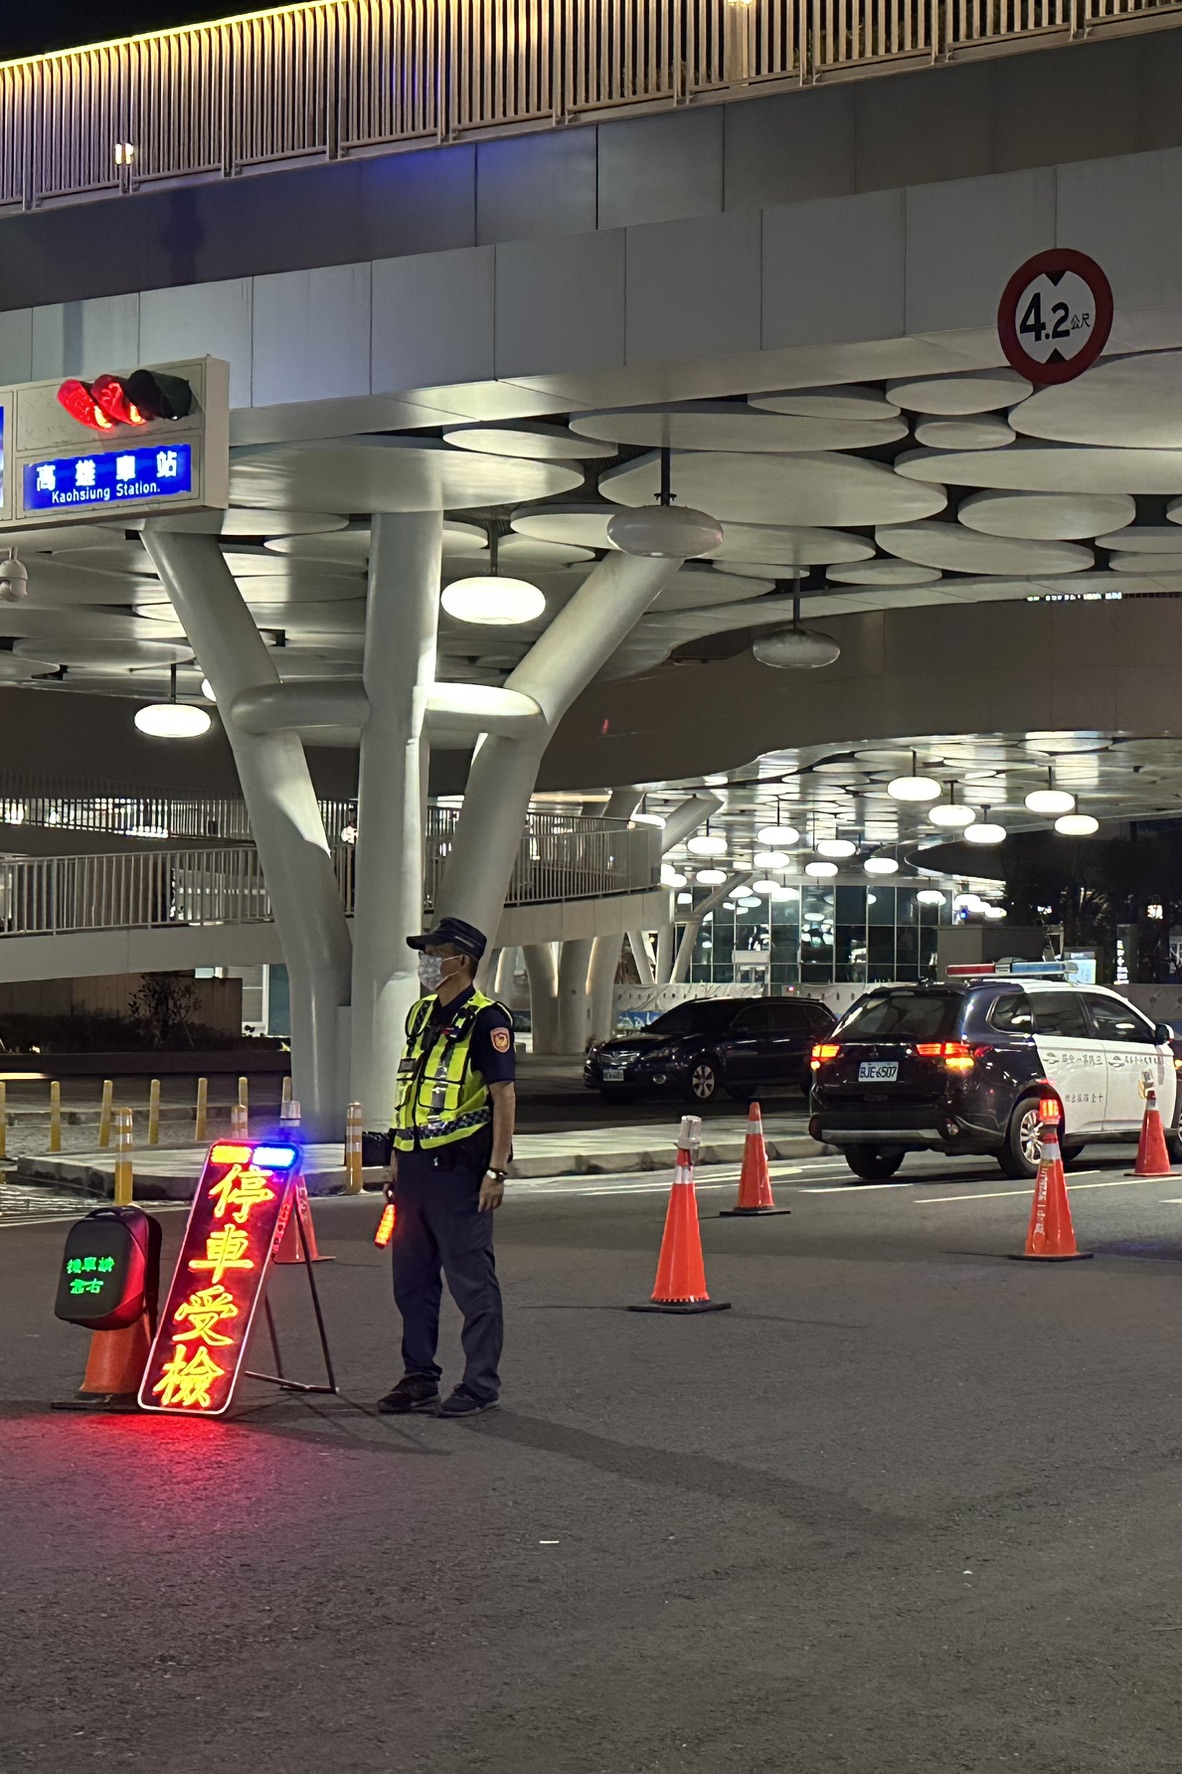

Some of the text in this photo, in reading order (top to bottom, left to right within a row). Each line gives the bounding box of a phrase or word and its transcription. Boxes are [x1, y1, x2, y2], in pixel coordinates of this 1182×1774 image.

[36, 450, 177, 492] 高雄車站
[52, 486, 110, 504] Kaohsiung
[152, 1164, 275, 1408] 停車受檢
